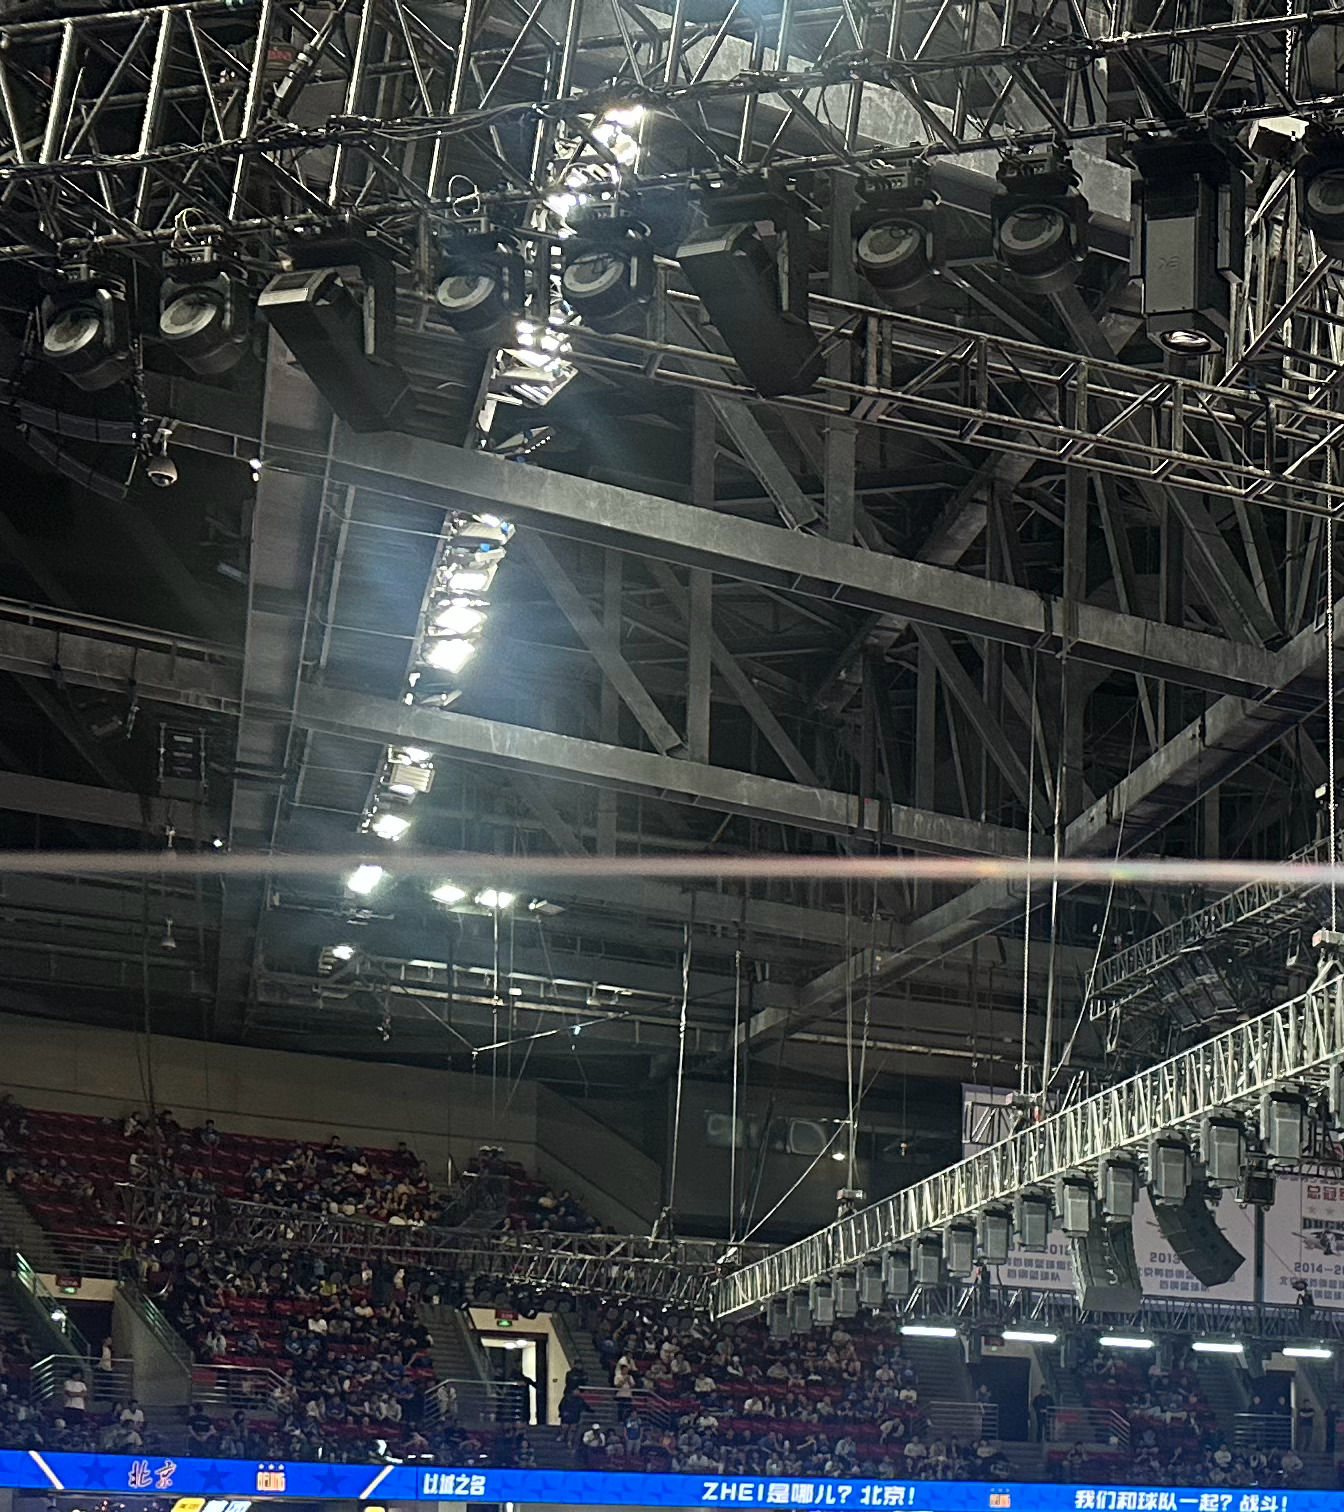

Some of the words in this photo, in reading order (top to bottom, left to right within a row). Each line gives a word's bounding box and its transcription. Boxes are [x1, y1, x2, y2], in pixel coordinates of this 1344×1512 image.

[127, 1459, 177, 1489] 北京
[423, 1473, 486, 1496] 以城之名
